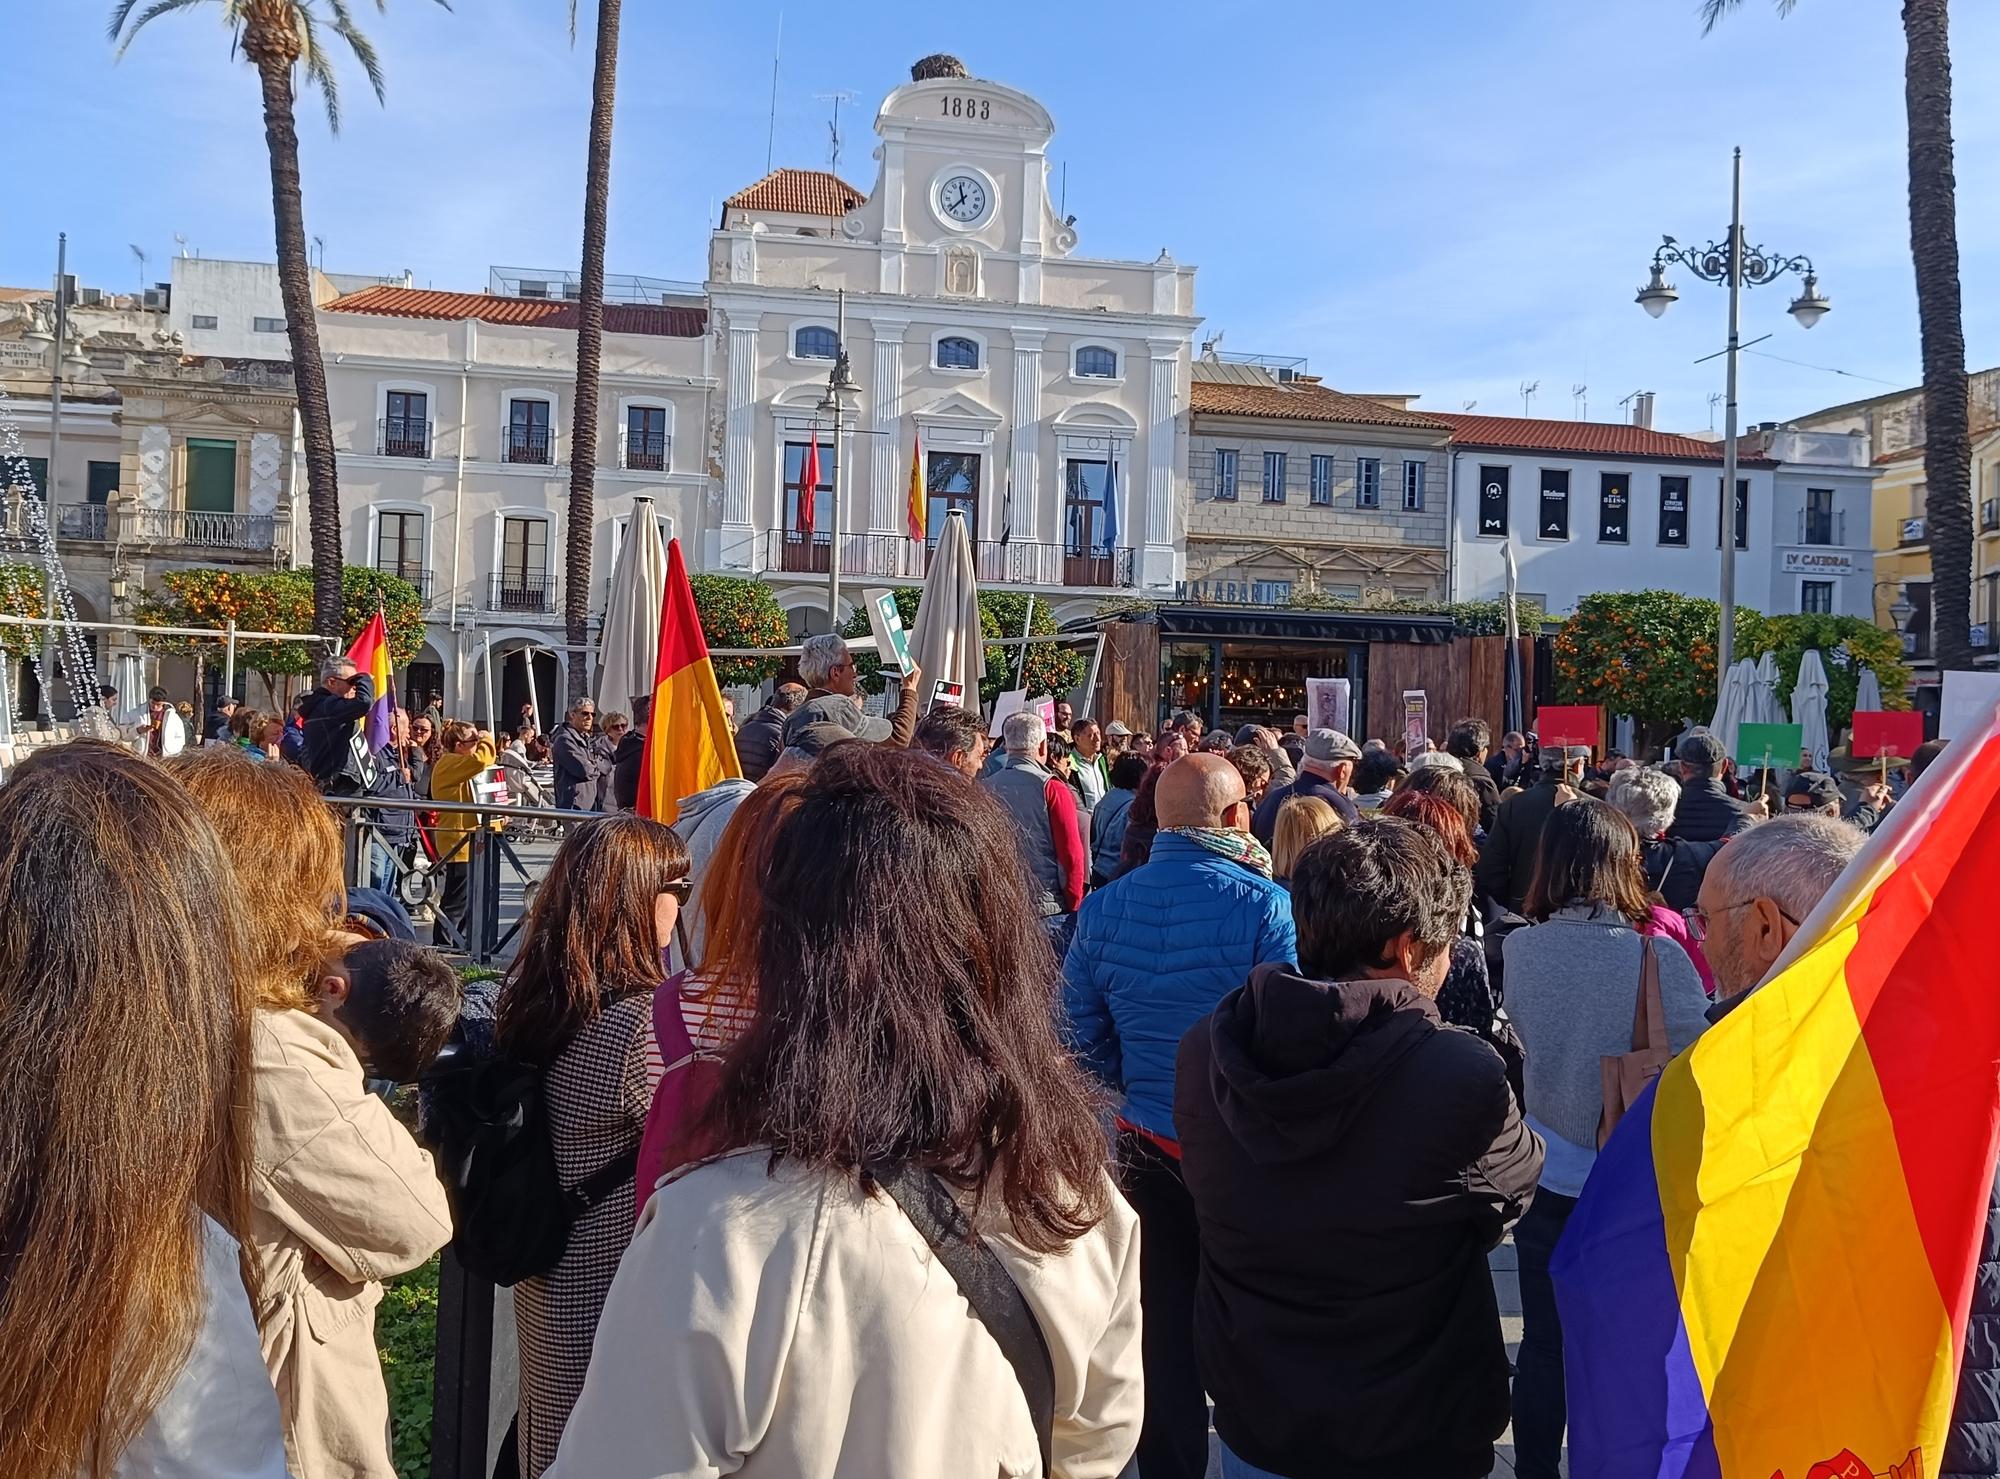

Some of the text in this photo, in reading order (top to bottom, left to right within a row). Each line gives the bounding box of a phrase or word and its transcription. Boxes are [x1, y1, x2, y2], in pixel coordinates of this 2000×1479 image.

[941, 96, 990, 120] 1883
[1485, 519, 1500, 528] M
[1547, 523, 1560, 531] A
[1606, 526, 1621, 535] M
[1668, 529, 1679, 537] B
